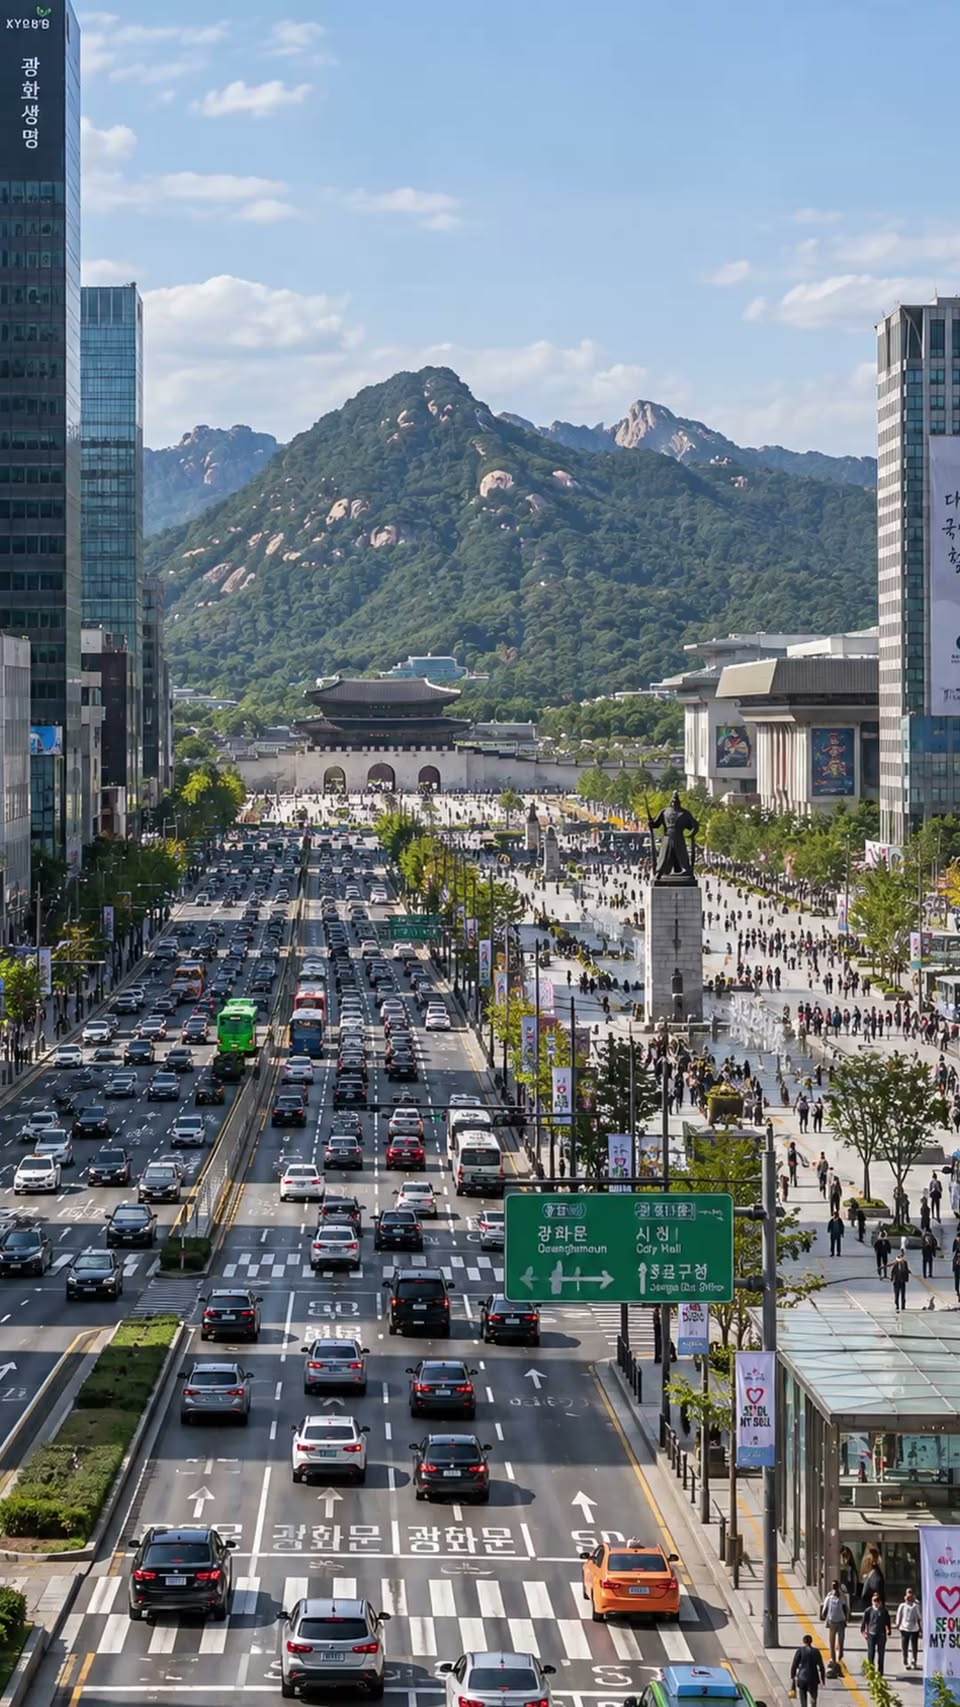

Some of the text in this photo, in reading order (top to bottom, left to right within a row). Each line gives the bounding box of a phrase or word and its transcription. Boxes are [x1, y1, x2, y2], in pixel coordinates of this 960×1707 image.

[21, 57, 40, 149] 광화생명
[408, 1526, 516, 1553] 광화문
[930, 1634, 946, 1648] MY
